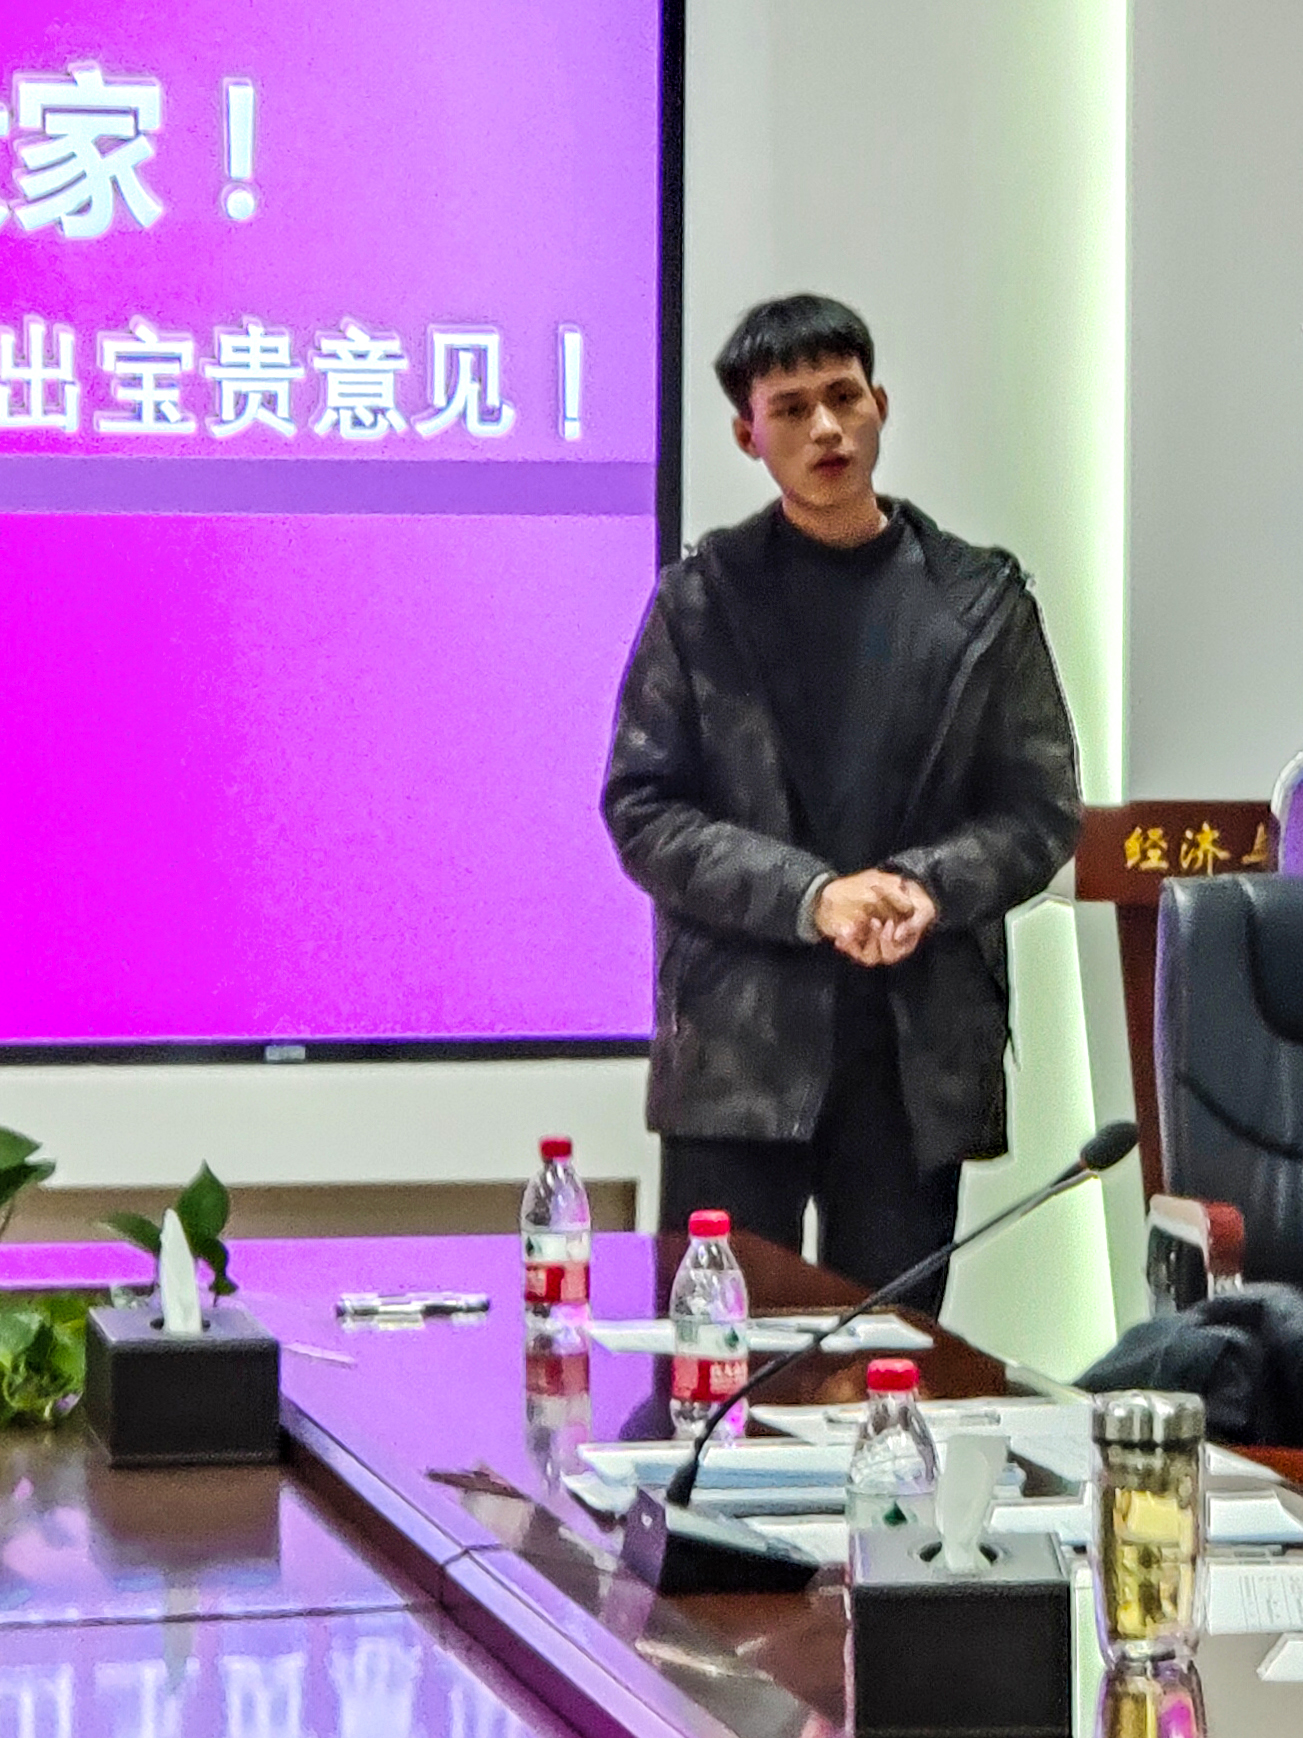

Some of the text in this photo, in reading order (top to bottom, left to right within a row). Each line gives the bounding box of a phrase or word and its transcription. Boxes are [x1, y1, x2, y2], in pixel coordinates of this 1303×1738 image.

[0, 64, 257, 239] 家！
[0, 318, 582, 438] 出宝贵意见！
